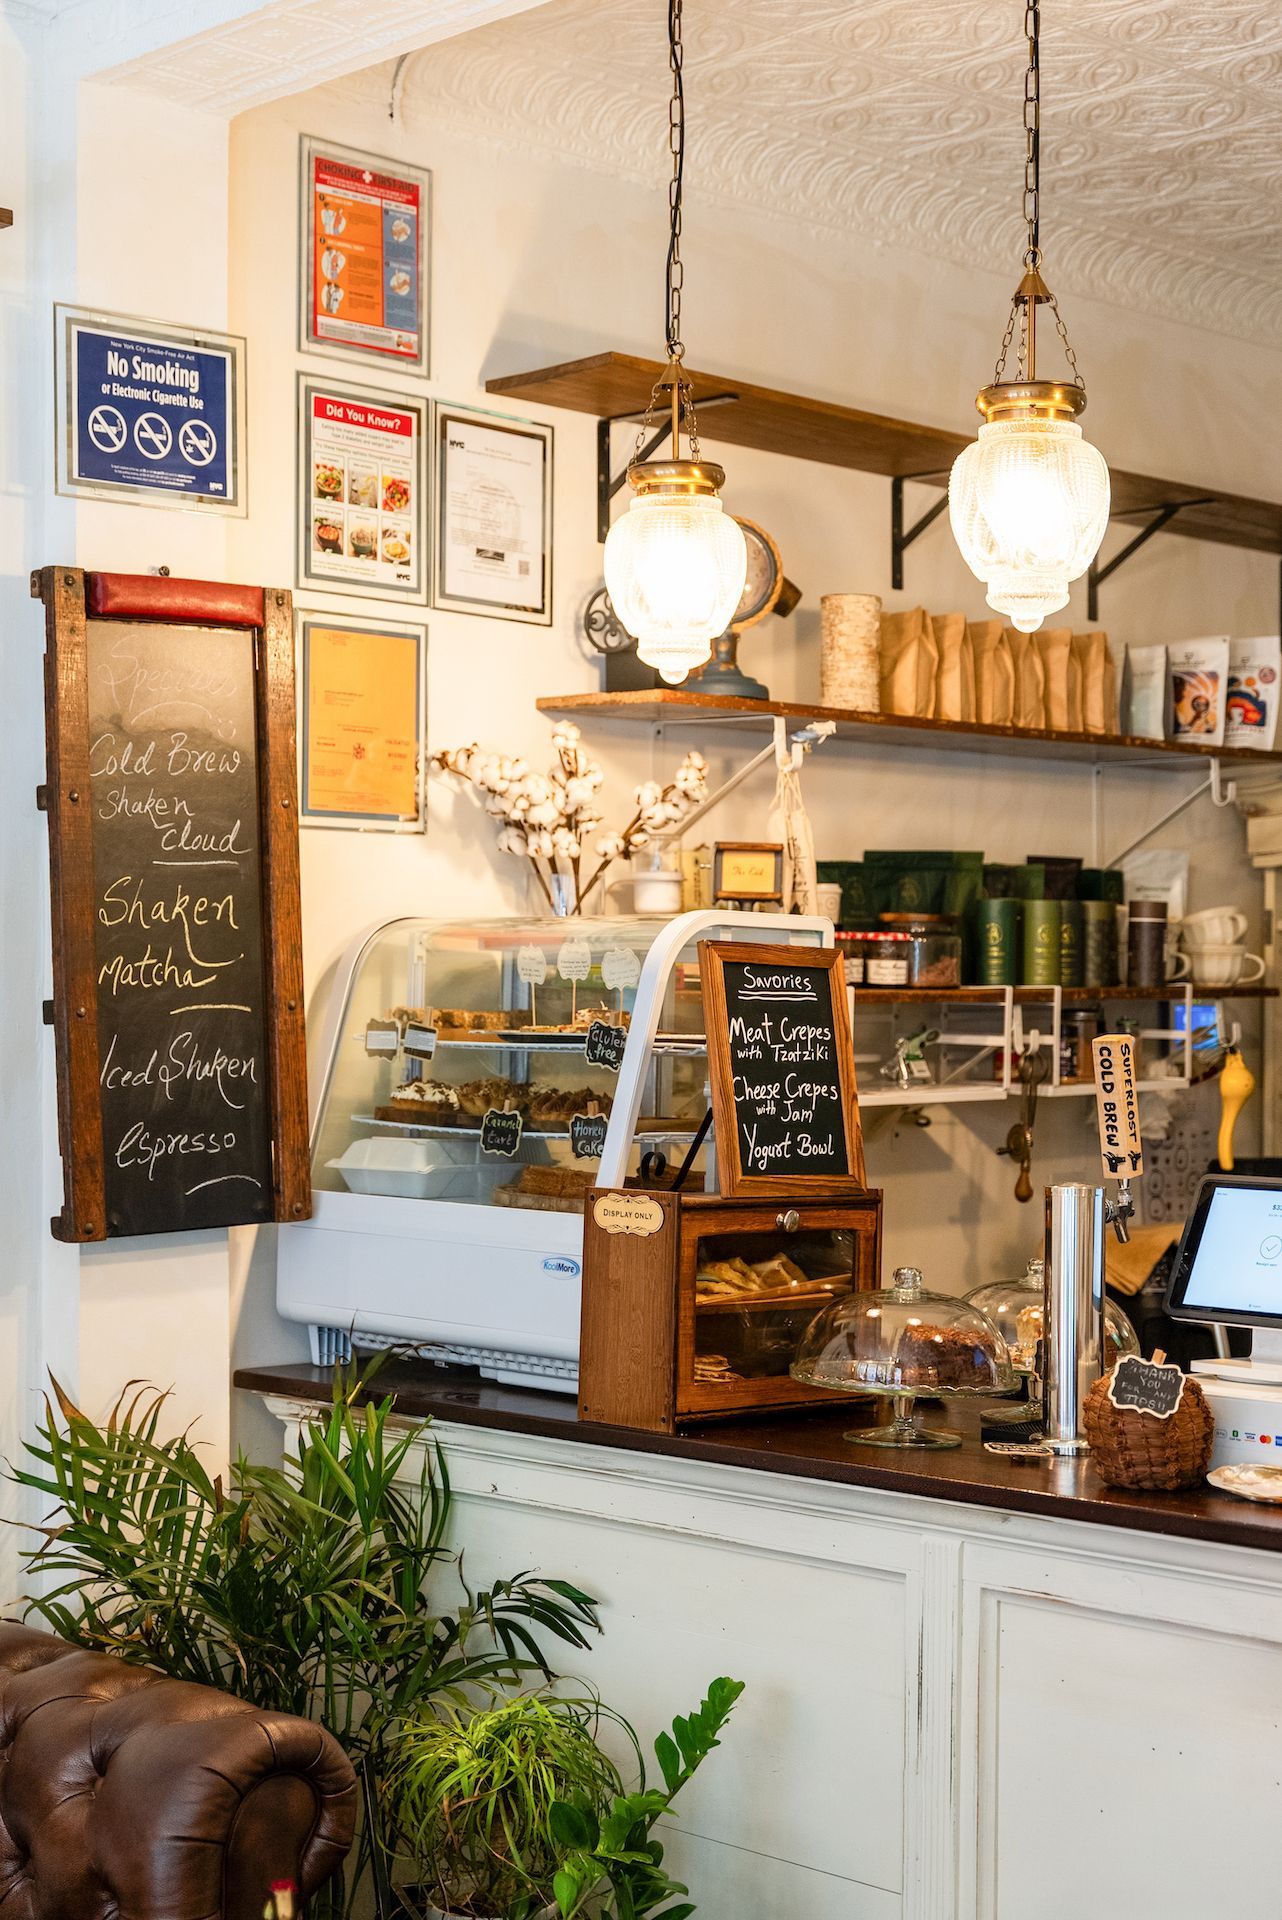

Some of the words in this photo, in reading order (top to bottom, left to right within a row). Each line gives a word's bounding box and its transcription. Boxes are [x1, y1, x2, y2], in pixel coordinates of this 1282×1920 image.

[318, 160, 361, 180] CHOKING
[110, 340, 122, 348] New
[123, 342, 135, 350] York
[135, 344, 146, 354] City
[146, 347, 177, 358] Smoke-Free
[177, 352, 186, 360] Air
[107, 350, 129, 378] No
[131, 355, 200, 393] Smoking
[101, 383, 111, 395] or
[112, 382, 151, 402] Electronic
[152, 389, 188, 408] Cigarette
[188, 395, 204, 410] Use
[325, 403, 344, 419] Did
[345, 408, 365, 423] You
[367, 412, 401, 430] Know?
[89, 732, 157, 777] Cold
[167, 731, 242, 776] Brew
[98, 786, 196, 829] Shaken
[97, 875, 245, 968] Shaken
[97, 944, 218, 996] Matcha
[742, 965, 812, 992] Savories
[729, 1012, 774, 1045] Meat
[780, 1016, 832, 1051] Crepes
[100, 1033, 154, 1091] Iced
[157, 1031, 258, 1109] Shaken
[736, 1045, 763, 1060] with
[770, 1043, 829, 1063] Tzatziki
[1099, 1045, 1115, 1094] COLD
[732, 1075, 781, 1102] Cheese
[784, 1072, 838, 1110] Crepes
[1120, 1042, 1138, 1143] SUPERLOST
[755, 1100, 777, 1116] with
[780, 1099, 814, 1124] Jam
[1103, 1101, 1120, 1148] BREW
[573, 1120, 605, 1142] Honey
[742, 1123, 793, 1171] Yogurt
[796, 1133, 835, 1157] Bowl
[634, 1211, 653, 1220] ONLY
[1121, 1381, 1140, 1394] FOR
[1139, 1375, 1161, 1390] YOU
